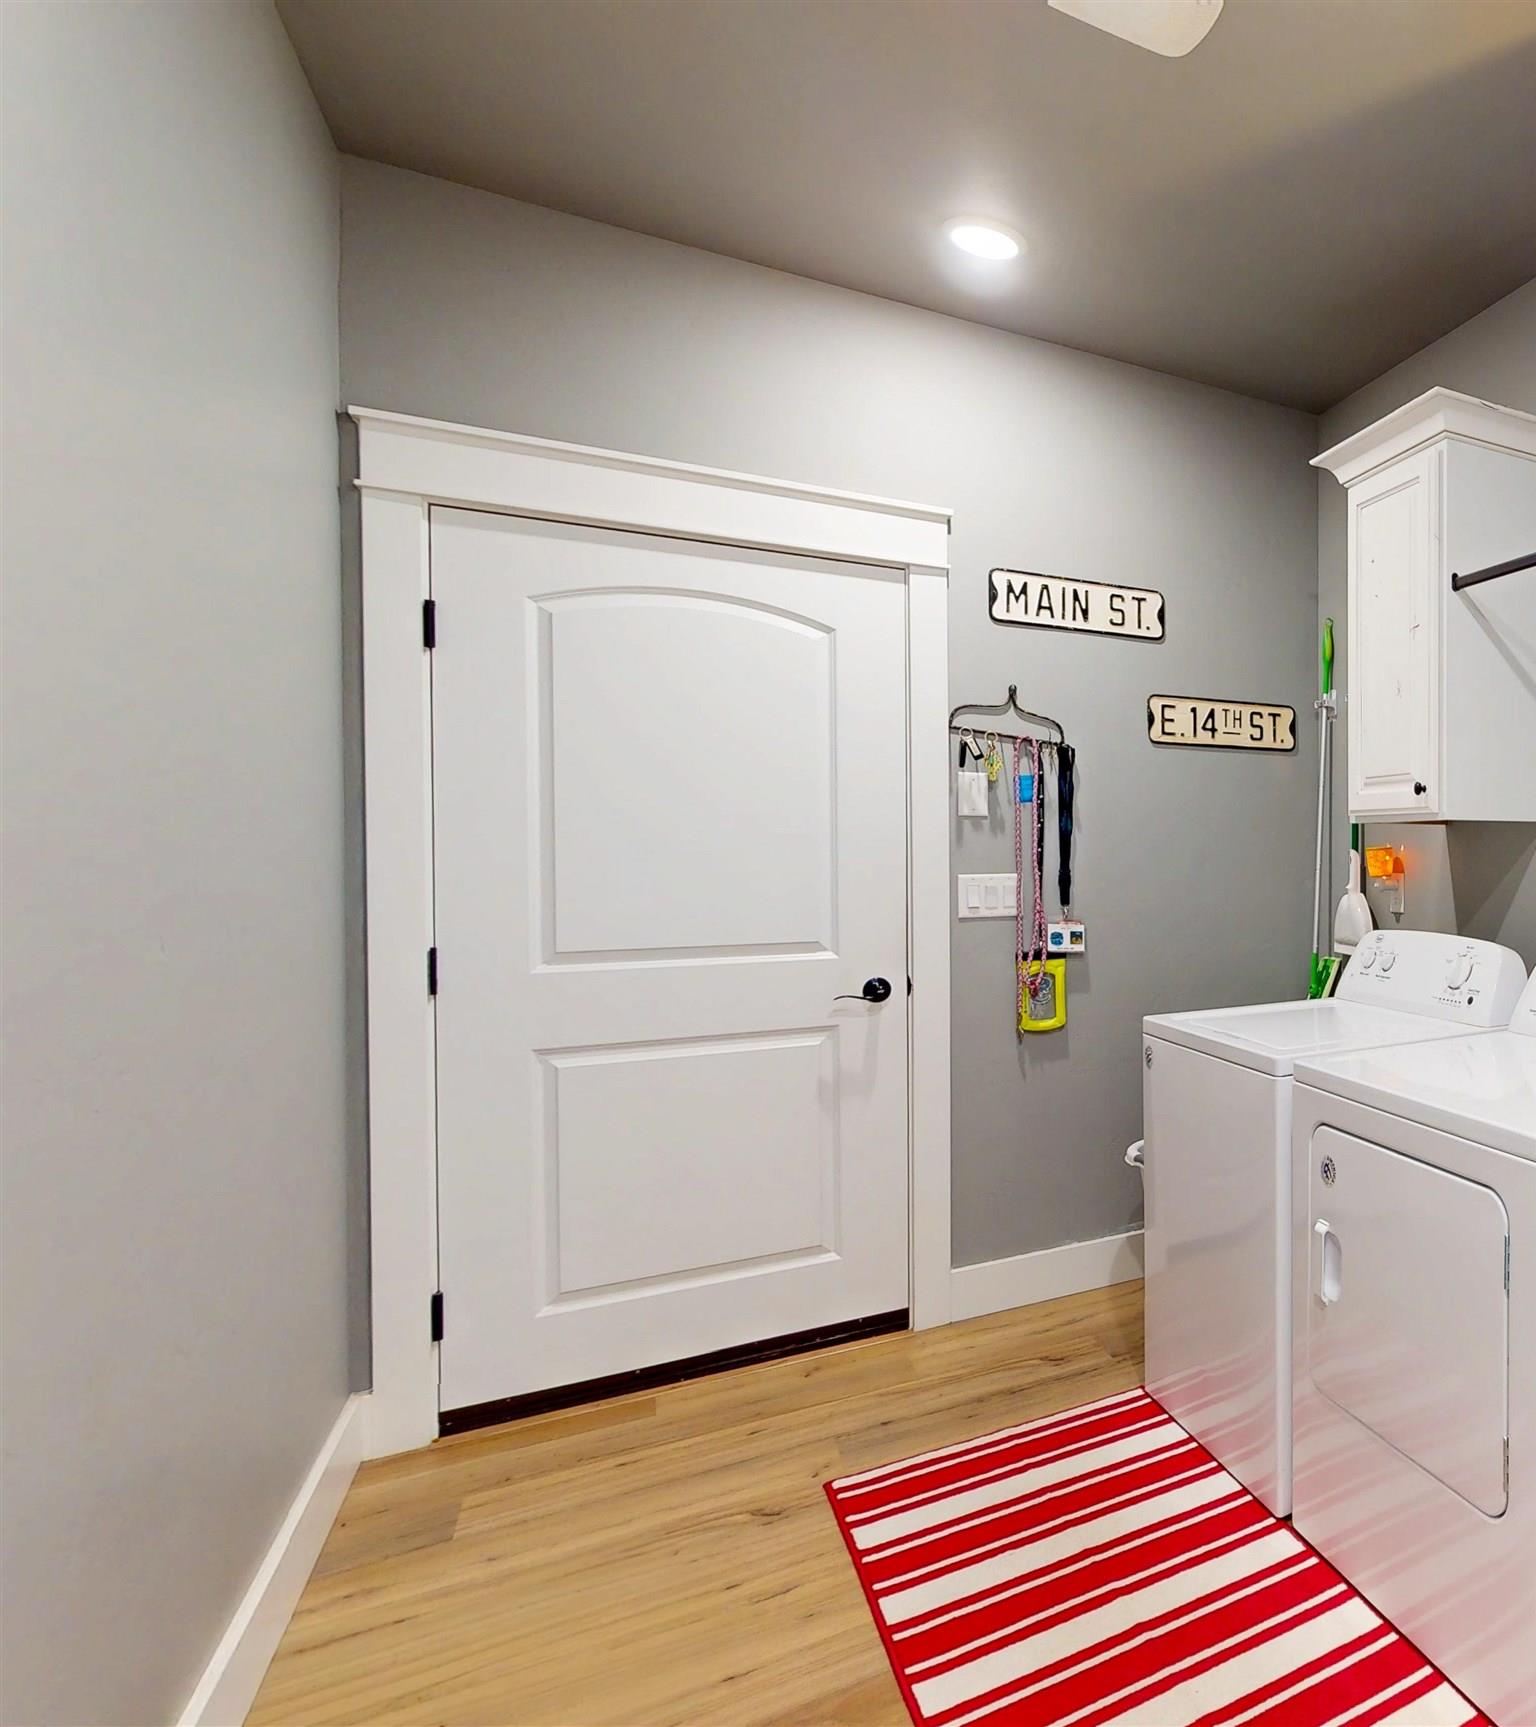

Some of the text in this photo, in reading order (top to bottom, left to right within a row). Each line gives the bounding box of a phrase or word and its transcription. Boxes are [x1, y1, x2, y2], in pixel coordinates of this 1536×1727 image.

[1005, 578, 1151, 632] MAIN ST.
[1249, 711, 1286, 745] ST.
